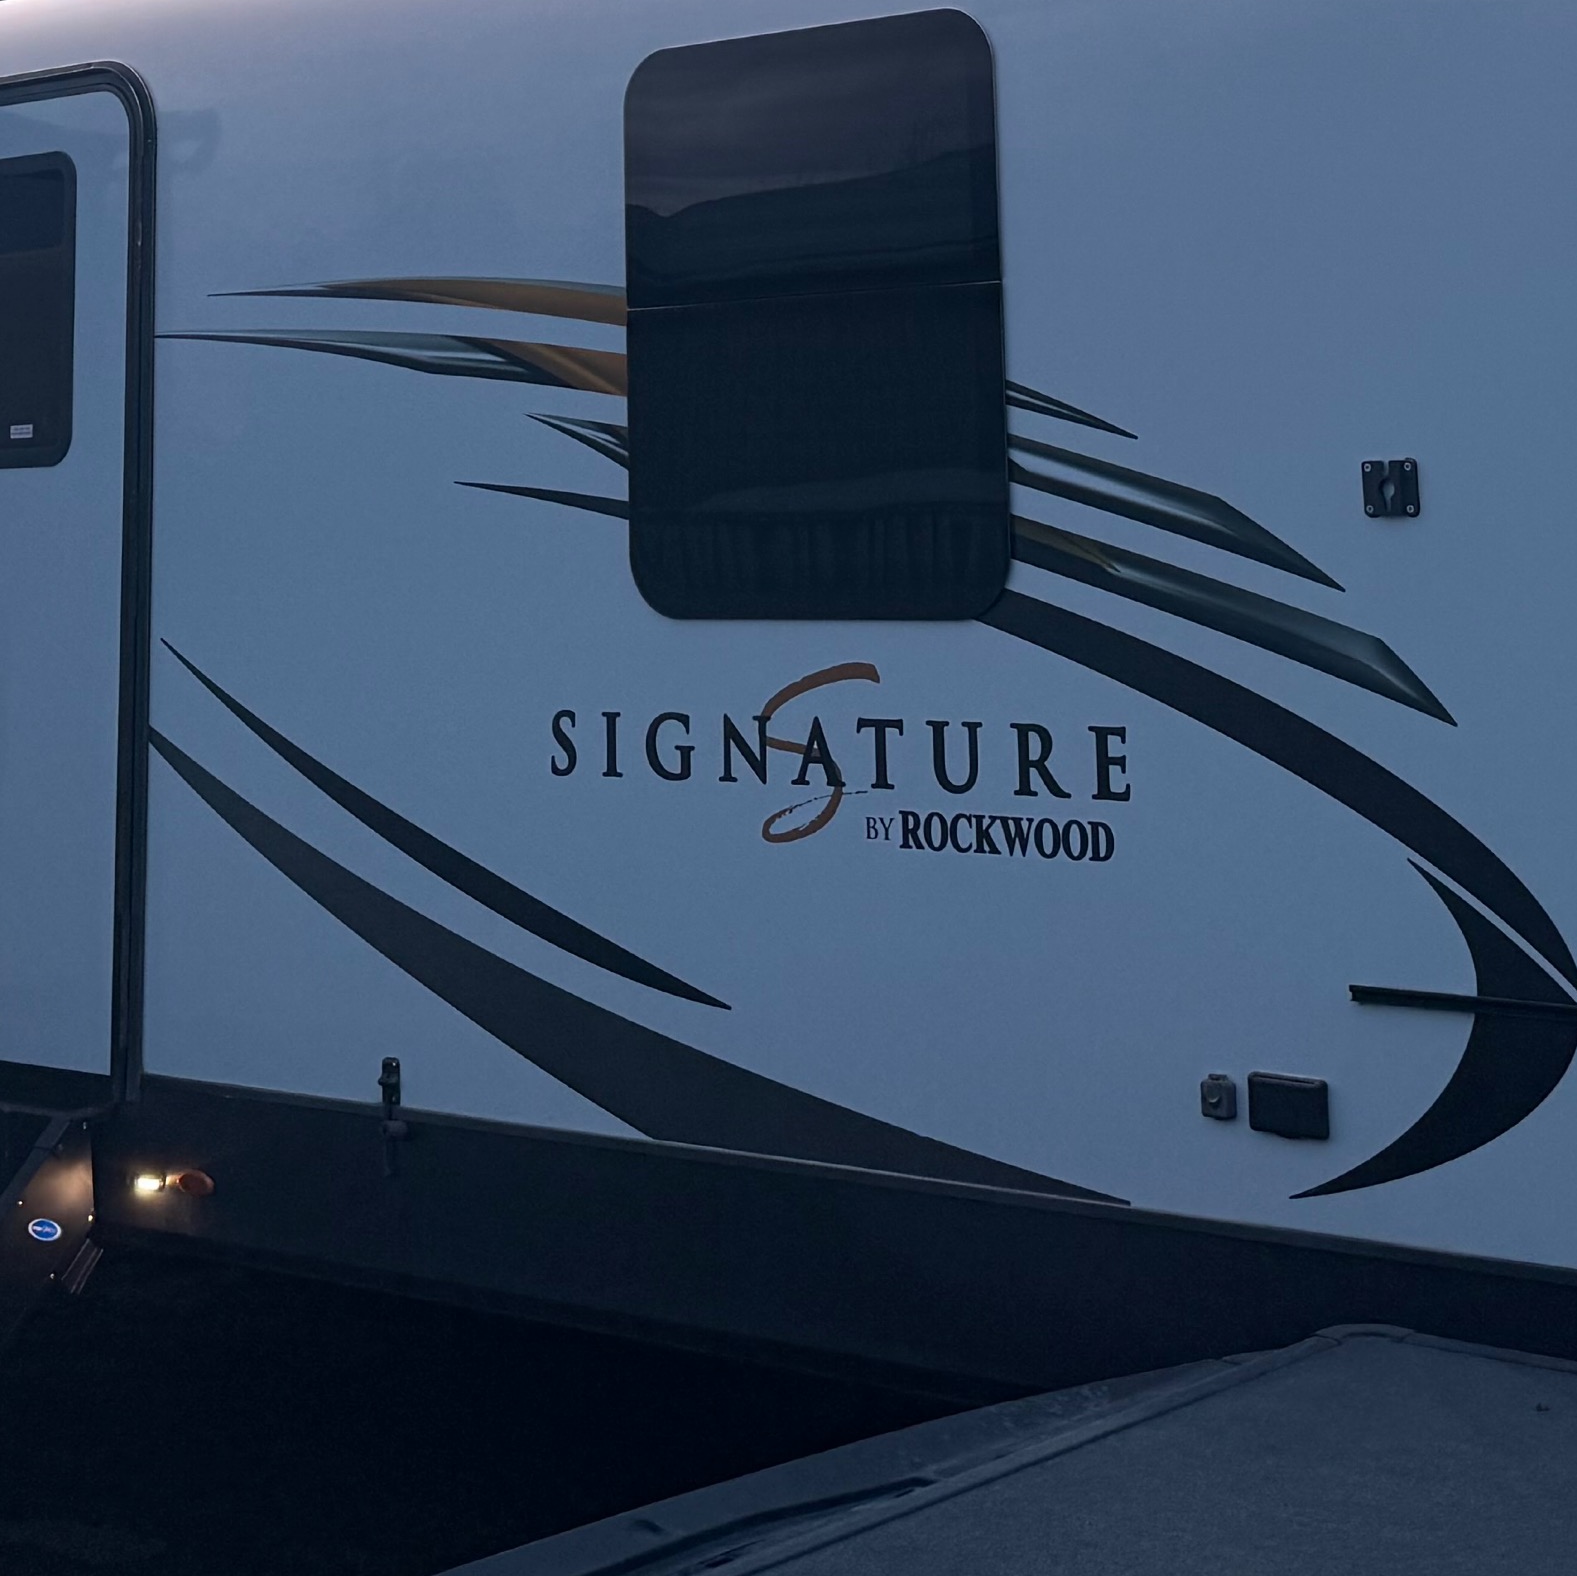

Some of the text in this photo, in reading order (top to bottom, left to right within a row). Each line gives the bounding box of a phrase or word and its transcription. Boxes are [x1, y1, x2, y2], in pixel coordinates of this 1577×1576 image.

[550, 709, 1131, 803] SIGNATURE
[866, 809, 1115, 862] BY ROCKWOOD
